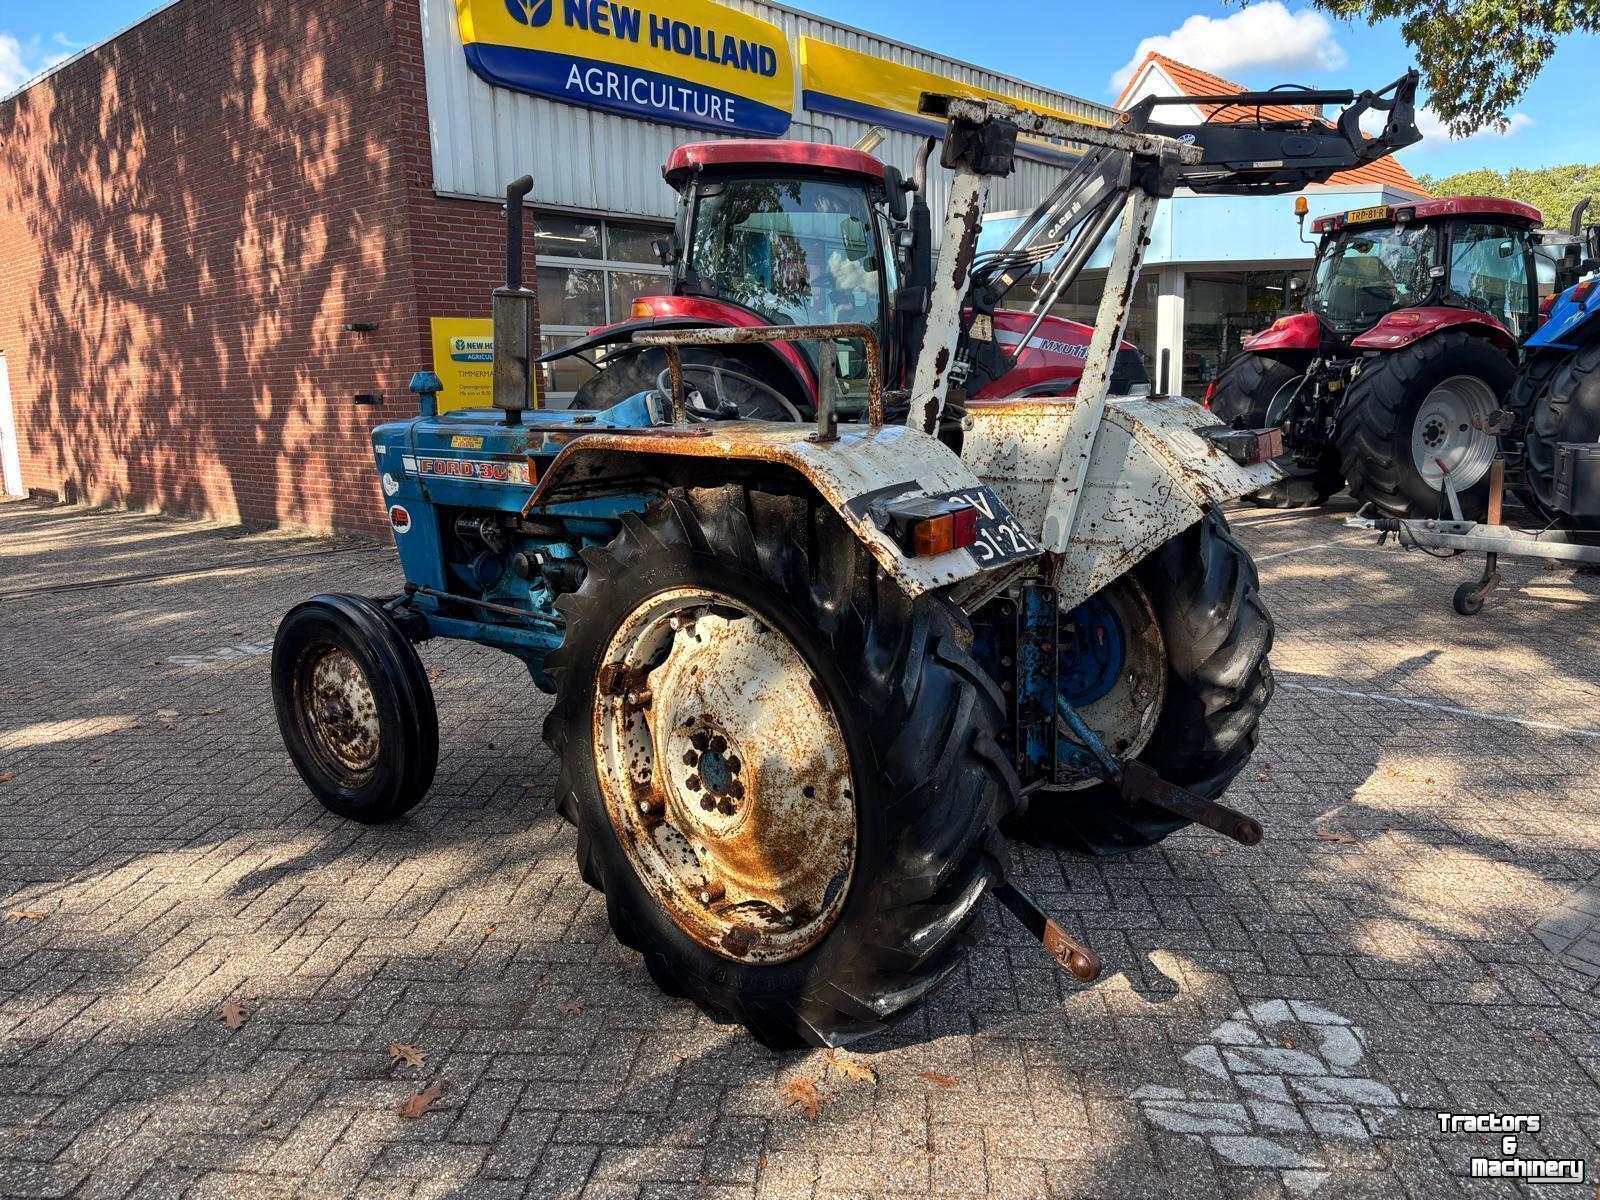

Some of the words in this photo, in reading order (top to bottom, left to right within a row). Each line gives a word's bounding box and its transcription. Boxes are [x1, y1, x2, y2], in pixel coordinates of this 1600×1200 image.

[564, 0, 641, 43] NEW
[650, 13, 777, 78] HOLLAND
[565, 63, 736, 124] AGRICULTURE
[1351, 208, 1384, 220] TRP-81-R
[1048, 210, 1073, 239] CASE
[466, 342, 483, 350] NEW
[1041, 340, 1089, 358] MXU11
[421, 460, 474, 476] FORD
